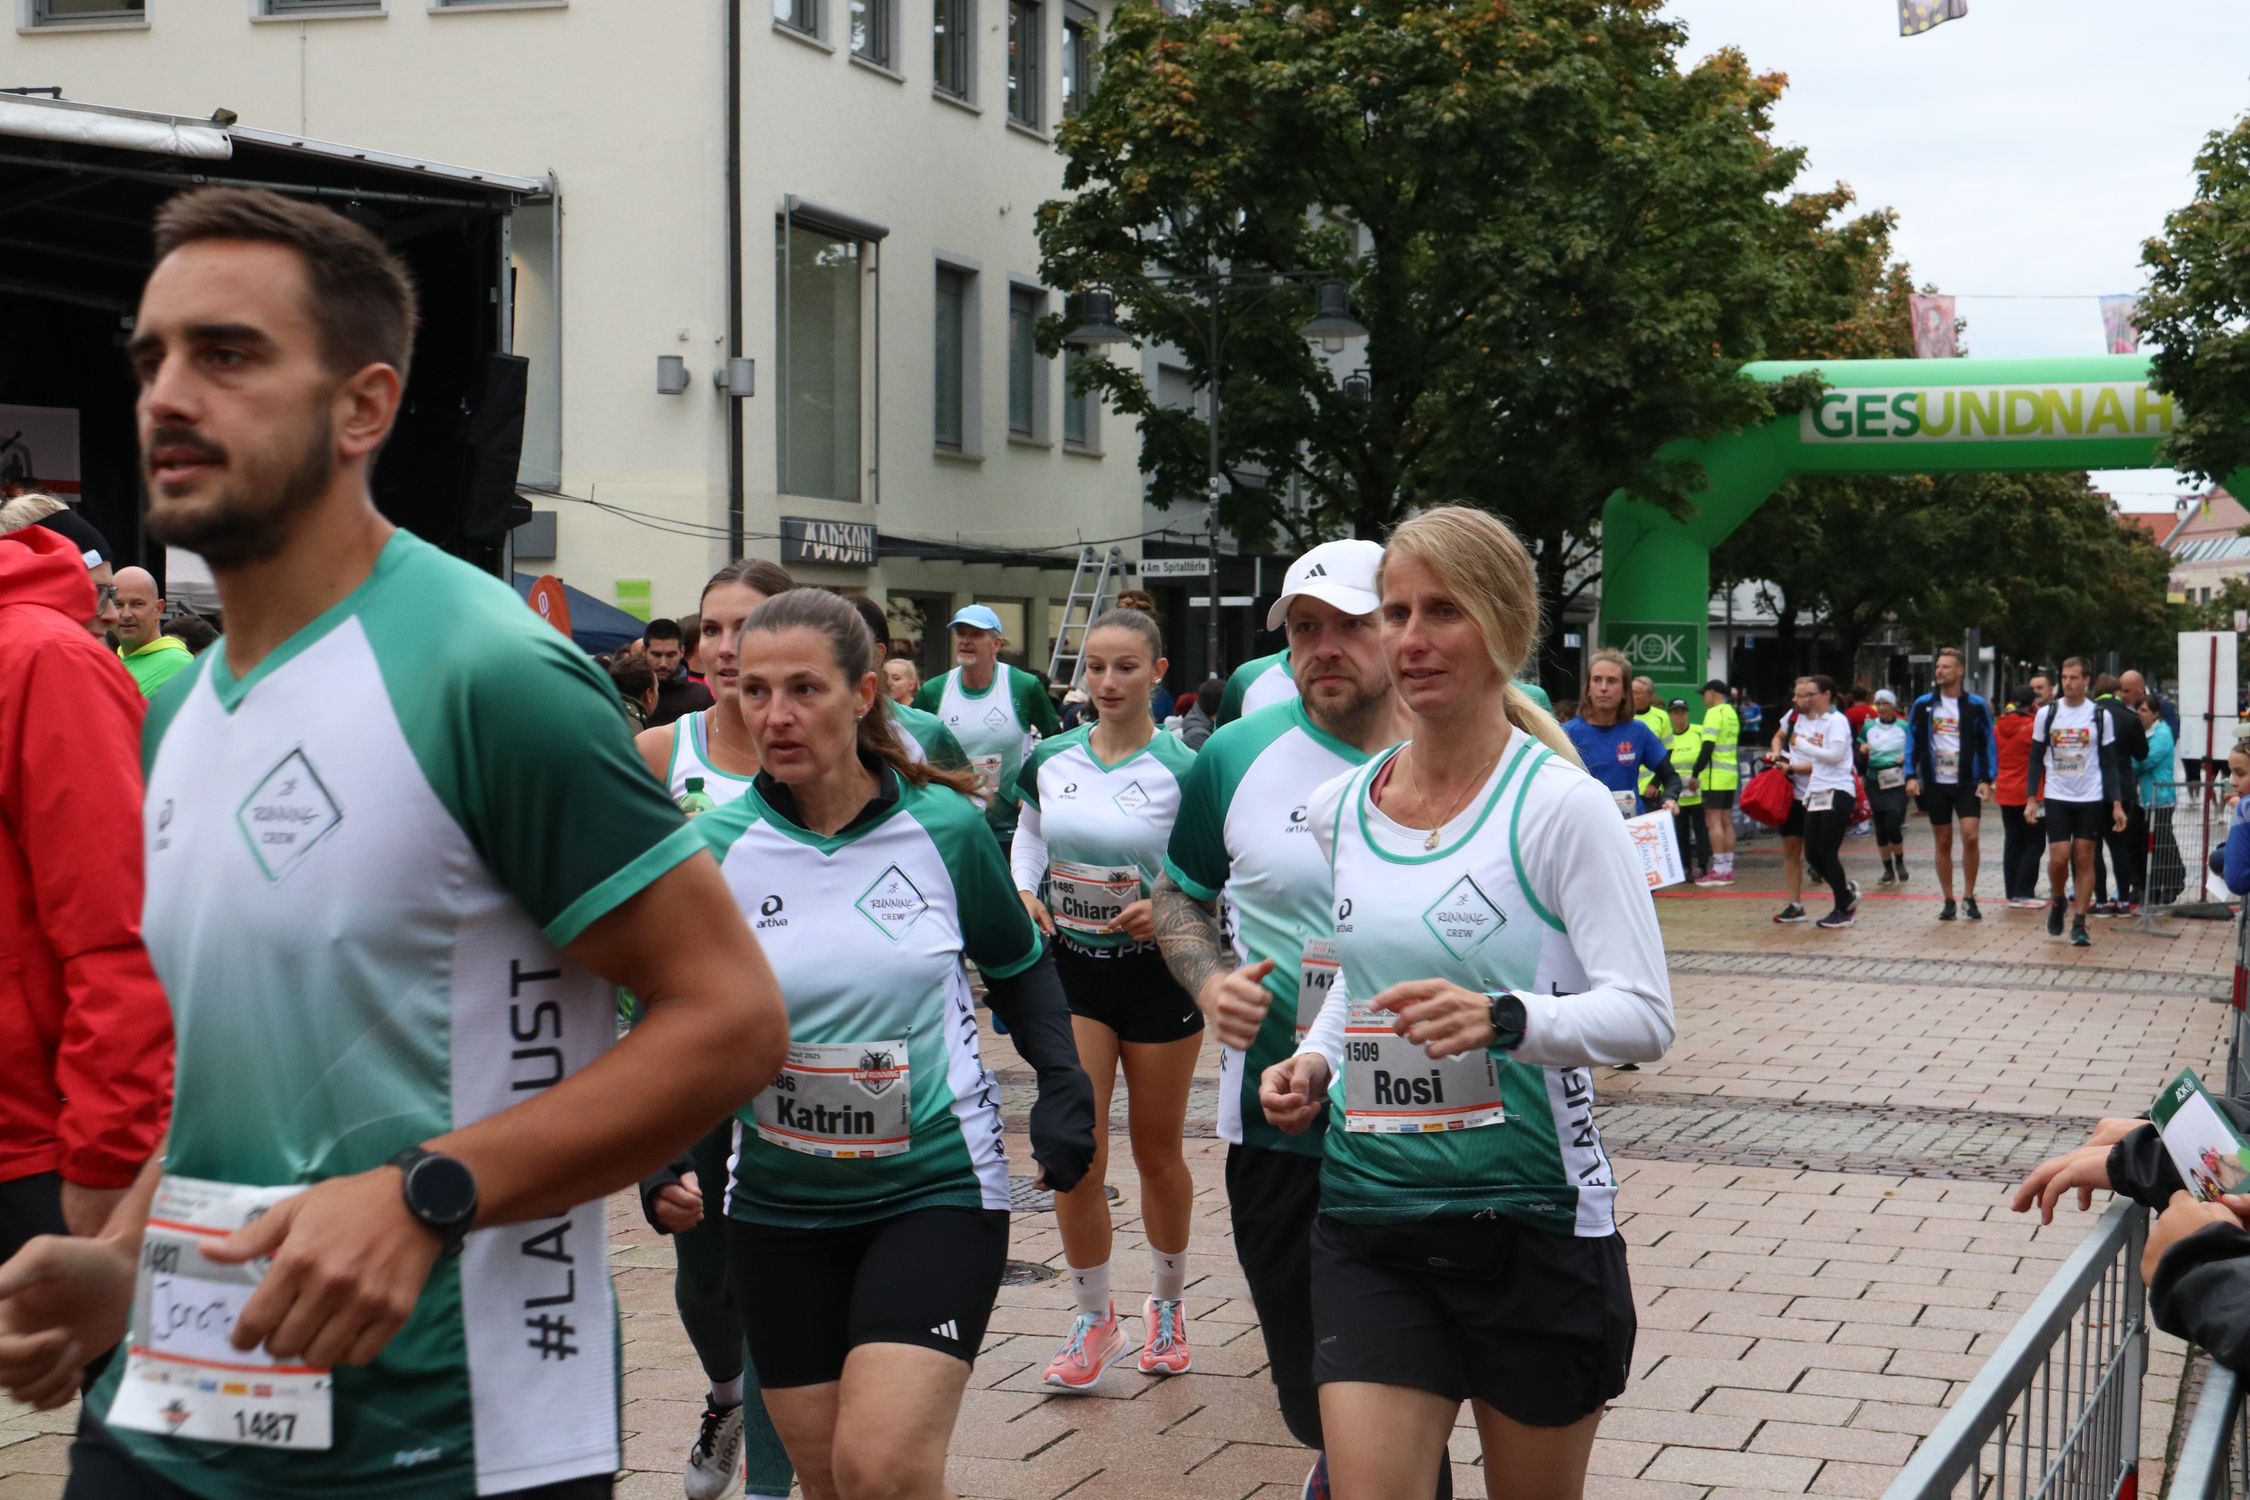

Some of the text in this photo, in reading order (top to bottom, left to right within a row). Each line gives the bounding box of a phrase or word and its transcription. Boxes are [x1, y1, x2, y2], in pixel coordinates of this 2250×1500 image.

[1812, 387, 2173, 438] GESUNDNAH
[1146, 561, 1207, 573] Am Spitaltörle
[1622, 633, 1686, 664] AOK
[1052, 880, 1075, 895] 1485
[869, 898, 917, 911] RUNNING
[1062, 896, 1122, 921] Chiara
[756, 916, 788, 929] artiva
[881, 913, 906, 921] CREW
[1435, 911, 1490, 926] RUNNING
[1446, 929, 1474, 938] CREW
[1117, 938, 1157, 959] PR
[1304, 971, 1335, 991] 147
[1345, 1041, 1379, 1062] 1509
[770, 1073, 797, 1092] 86
[1373, 1069, 1445, 1106] Rosi
[2175, 1084, 2190, 1102] AOK
[776, 1095, 876, 1135] Katrin
[233, 1408, 298, 1443] 1487
[718, 1420, 744, 1475] BROO
